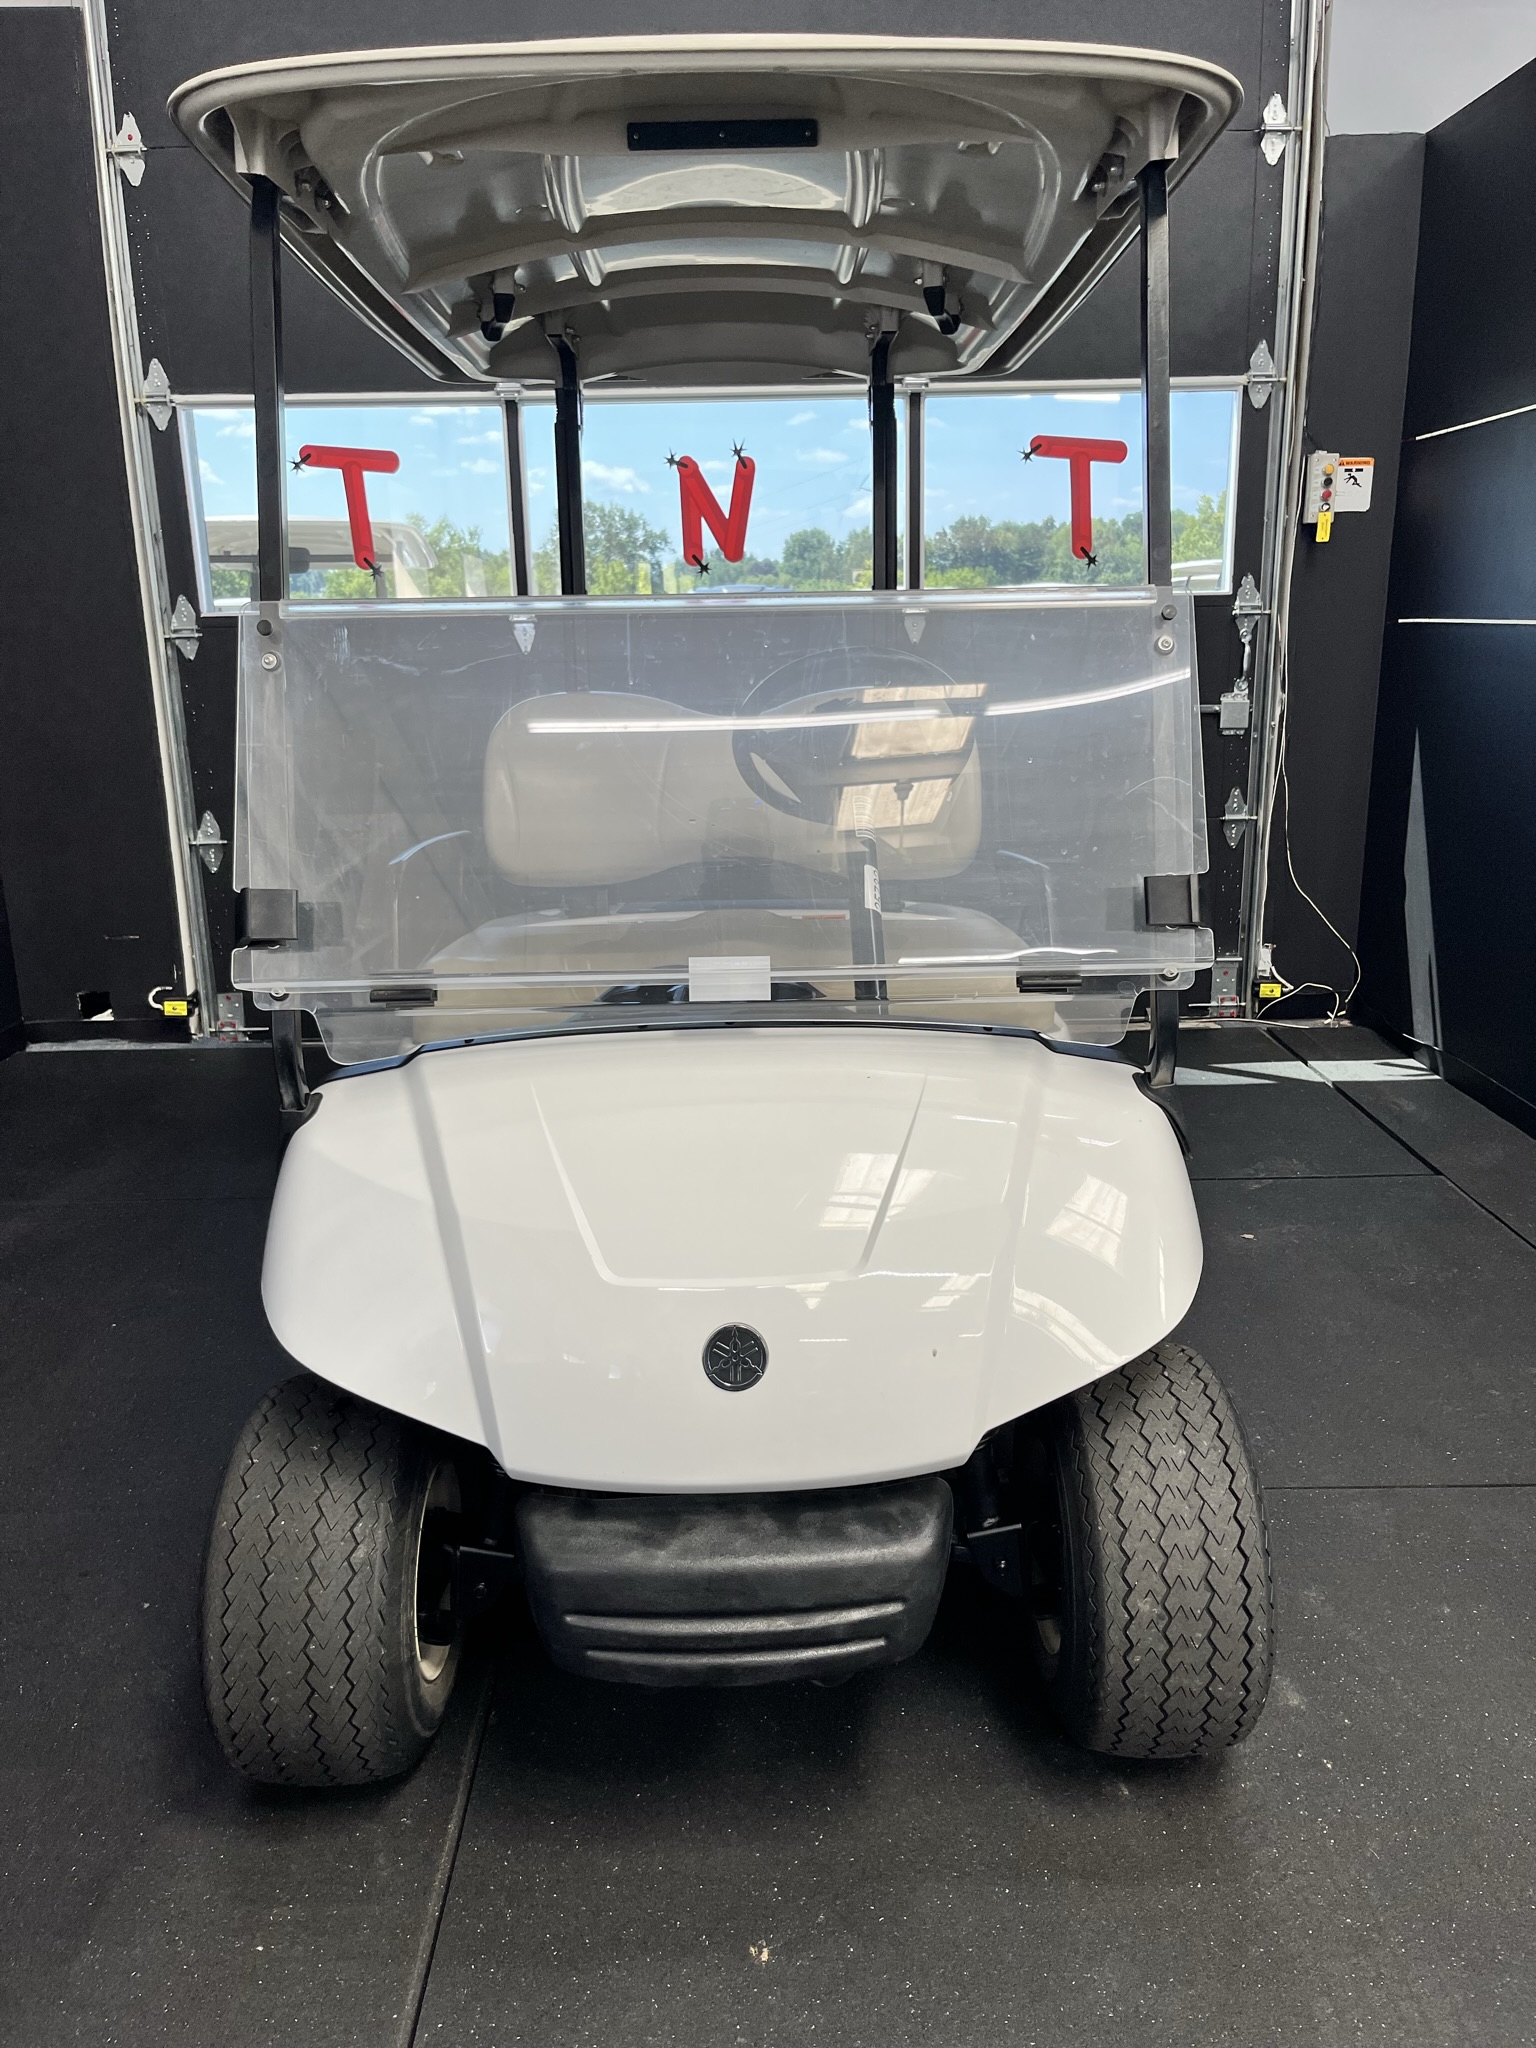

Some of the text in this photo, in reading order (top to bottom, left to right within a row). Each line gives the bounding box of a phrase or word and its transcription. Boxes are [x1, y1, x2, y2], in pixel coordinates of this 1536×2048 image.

[300, 435, 1128, 570] T N T
